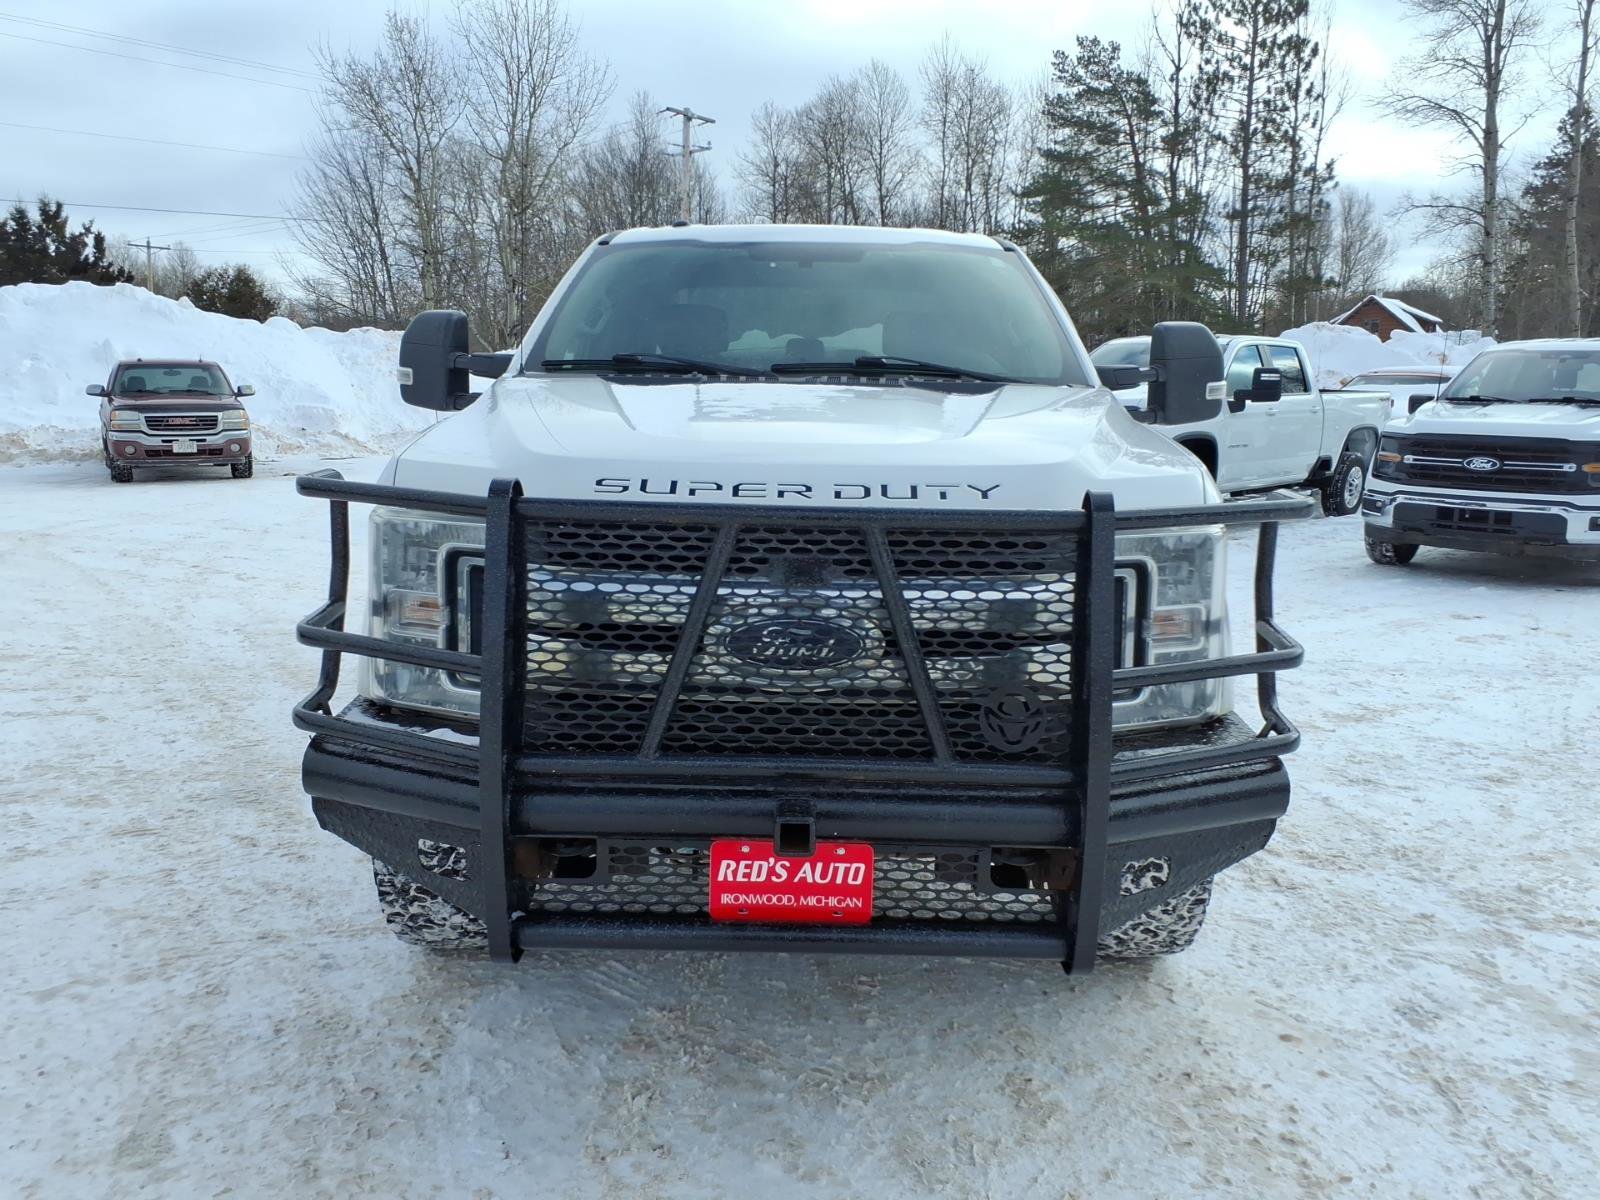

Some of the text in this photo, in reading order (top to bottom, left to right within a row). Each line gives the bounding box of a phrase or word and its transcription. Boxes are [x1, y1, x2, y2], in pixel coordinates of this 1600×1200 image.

[1470, 459, 1493, 468] Ford
[594, 478, 1001, 500] SUPER DUTY
[752, 626, 835, 658] Ford
[717, 857, 866, 885] RED'S AUTO
[720, 893, 863, 908] IRONWOOD, MICHIGAN
